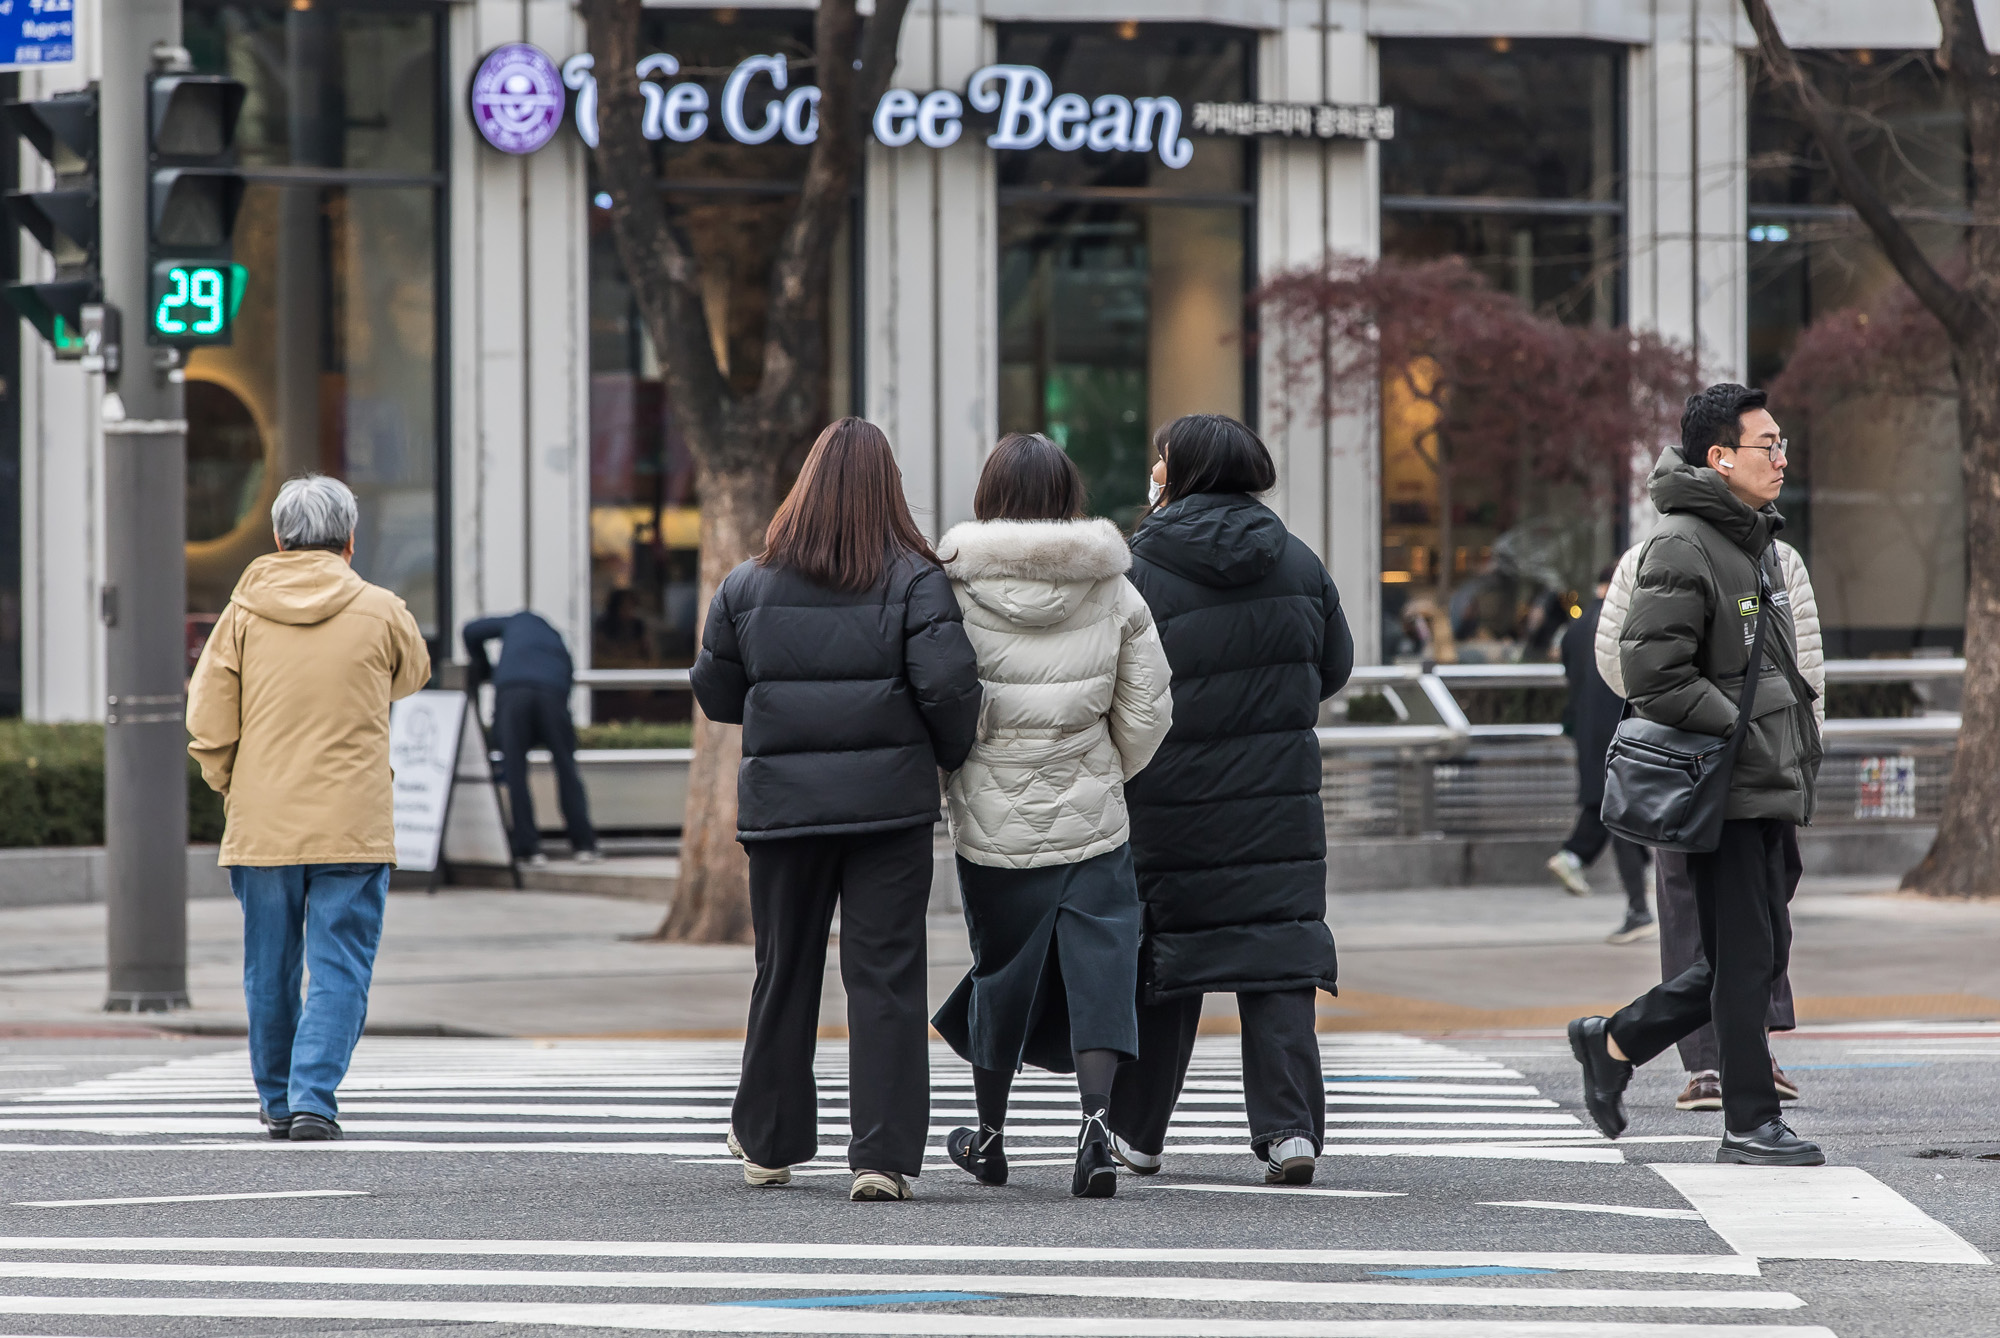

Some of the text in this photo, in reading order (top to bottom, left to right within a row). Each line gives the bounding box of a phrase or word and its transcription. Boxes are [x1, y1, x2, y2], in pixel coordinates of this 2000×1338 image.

[721, 53, 963, 148] Coee
[968, 64, 1194, 169] Bean
[155, 267, 224, 334] 29
